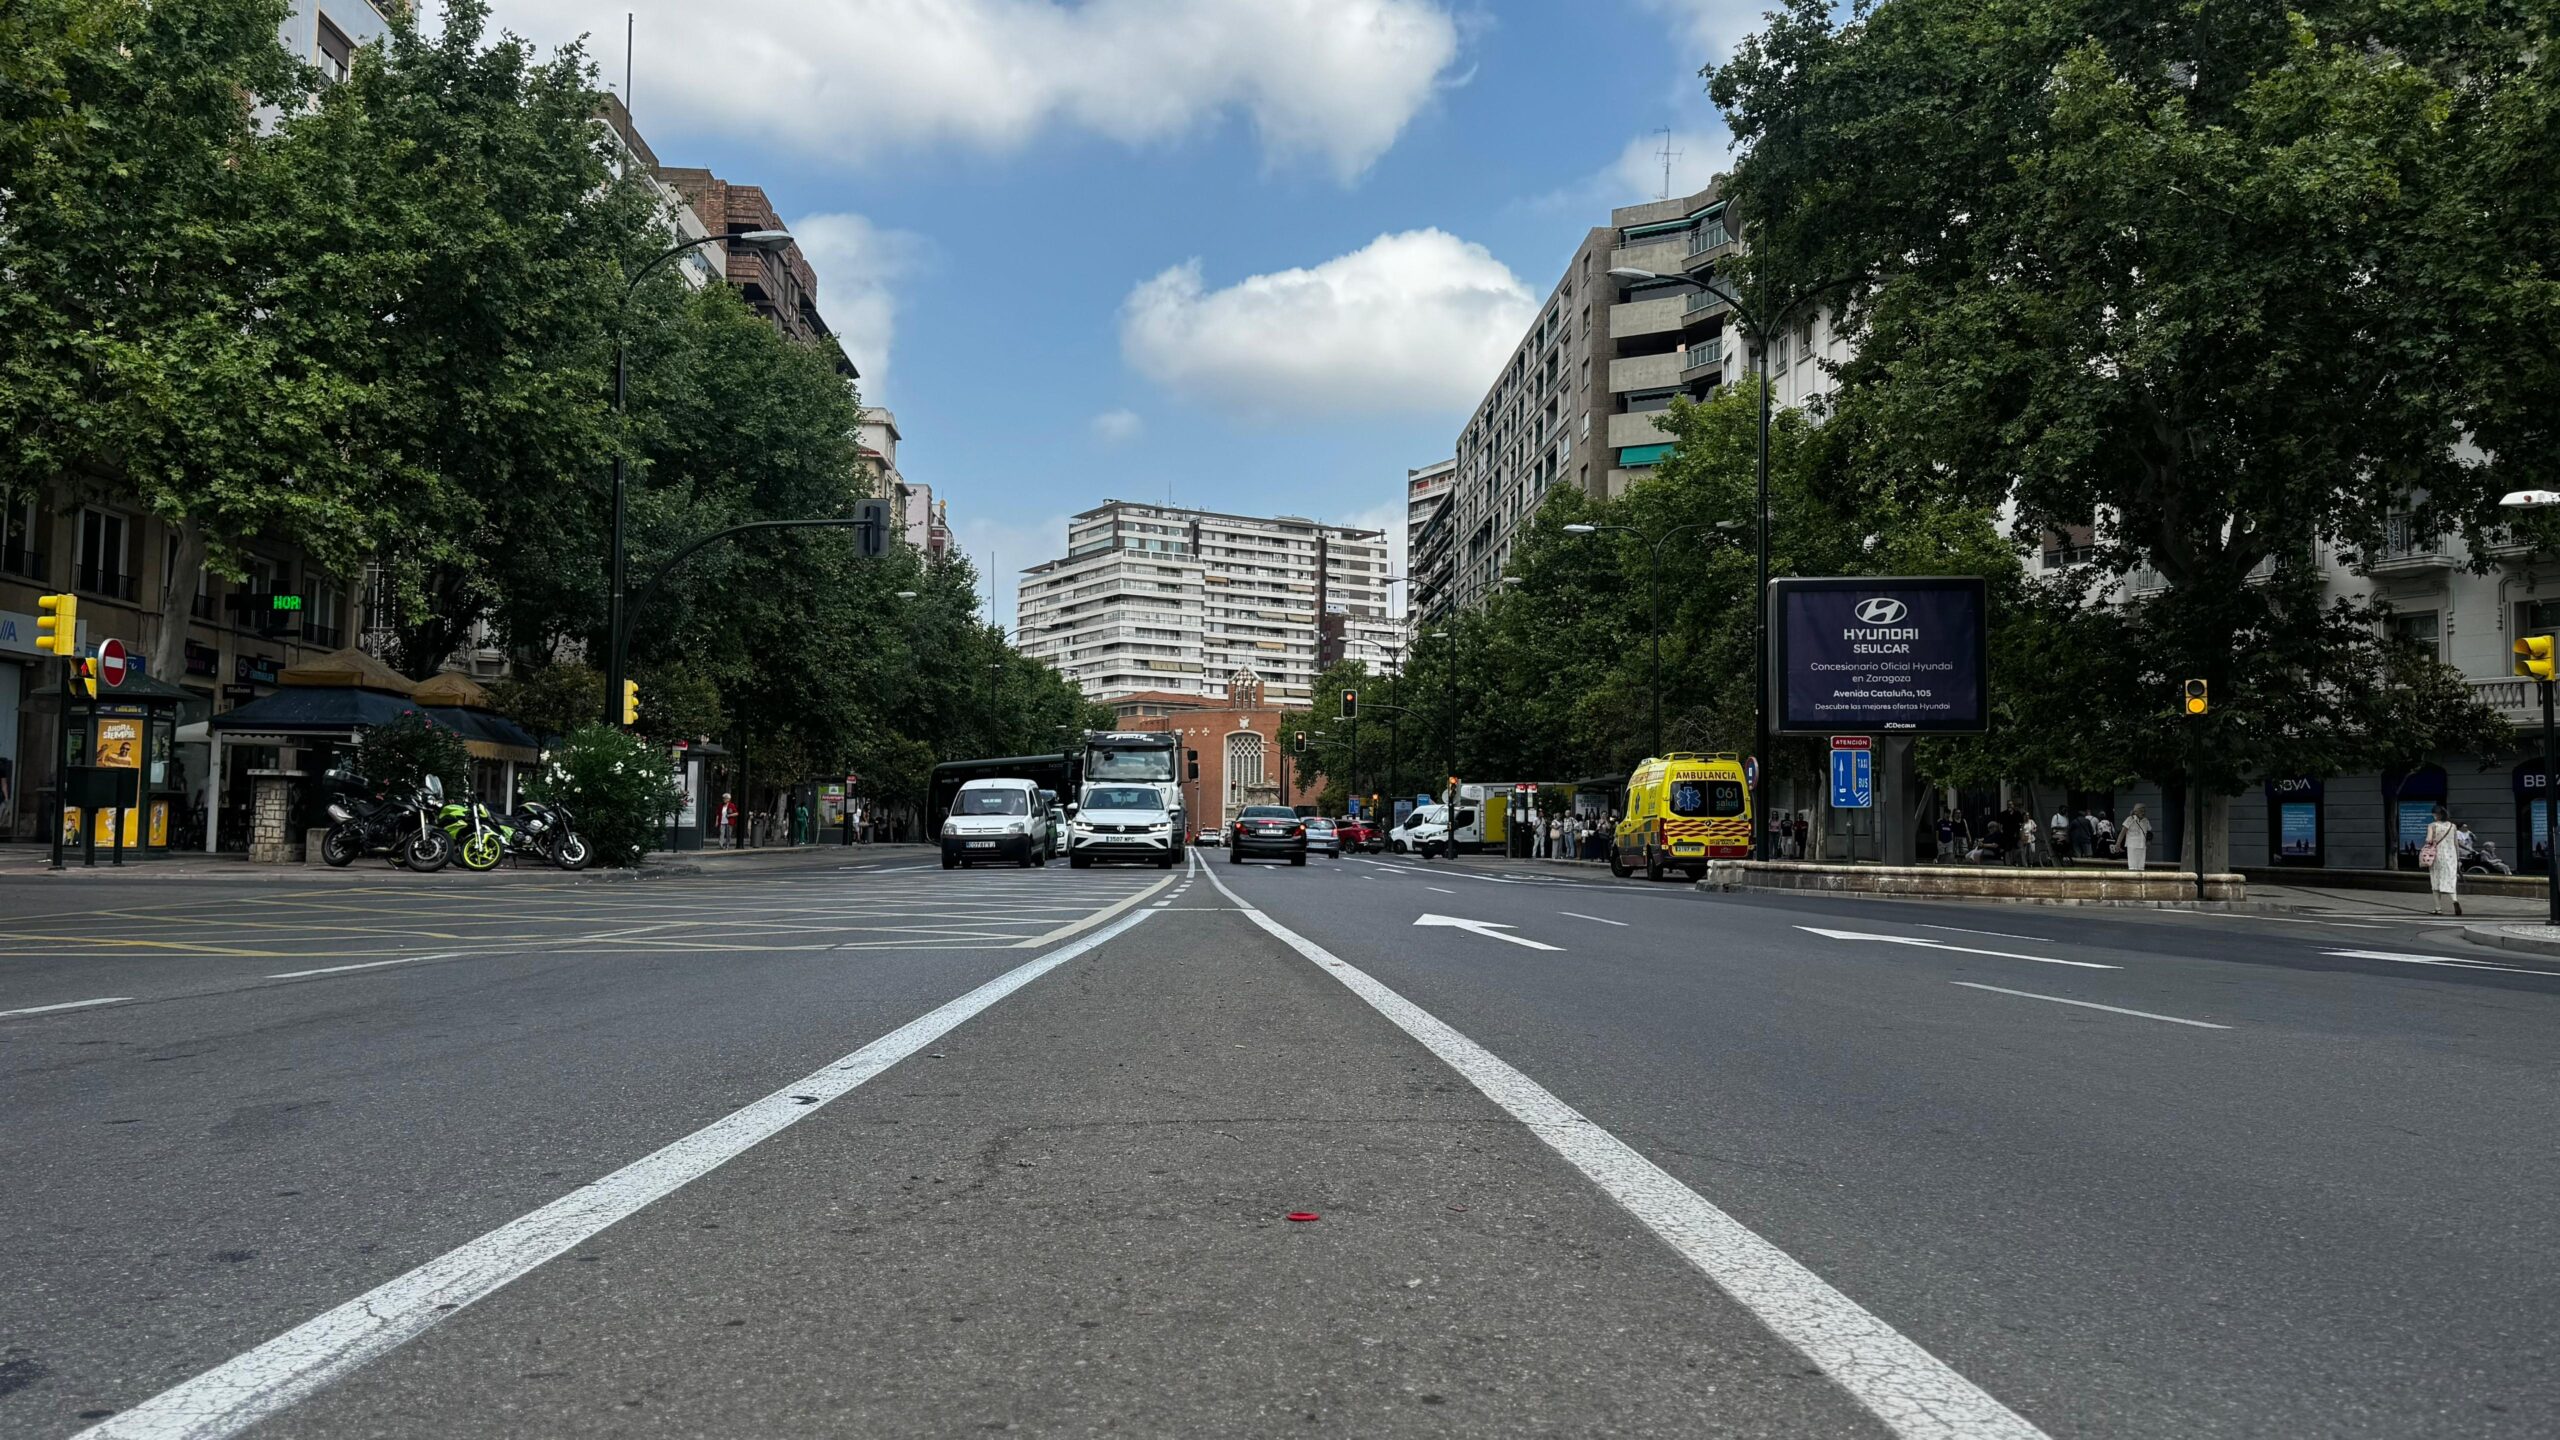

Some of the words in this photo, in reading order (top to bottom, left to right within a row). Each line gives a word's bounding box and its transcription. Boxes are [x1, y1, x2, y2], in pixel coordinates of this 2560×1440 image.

[1843, 628, 1919, 640] HYUNDAI
[1853, 644, 1910, 654] SEULCAR
[1810, 662, 1878, 671] Concesionario
[1880, 662, 1910, 671] Oficial
[1912, 662, 1953, 672] Hyundai
[1852, 675, 1864, 683] en
[1866, 674, 1911, 684] Zaragoza
[1833, 689, 1869, 697] Avenida
[1870, 689, 1915, 698] Cataluña,
[1862, 703, 1891, 711] mejores
[1919, 702, 1951, 711] Hyundai
[103, 731, 136, 739] SIEMPRE
[1857, 758, 1868, 769] TAXI
[1676, 771, 1737, 780] AMBULANCIA
[1858, 777, 1869, 788] BUS
[1716, 787, 1738, 799] 061
[1716, 799, 1739, 807] salud
